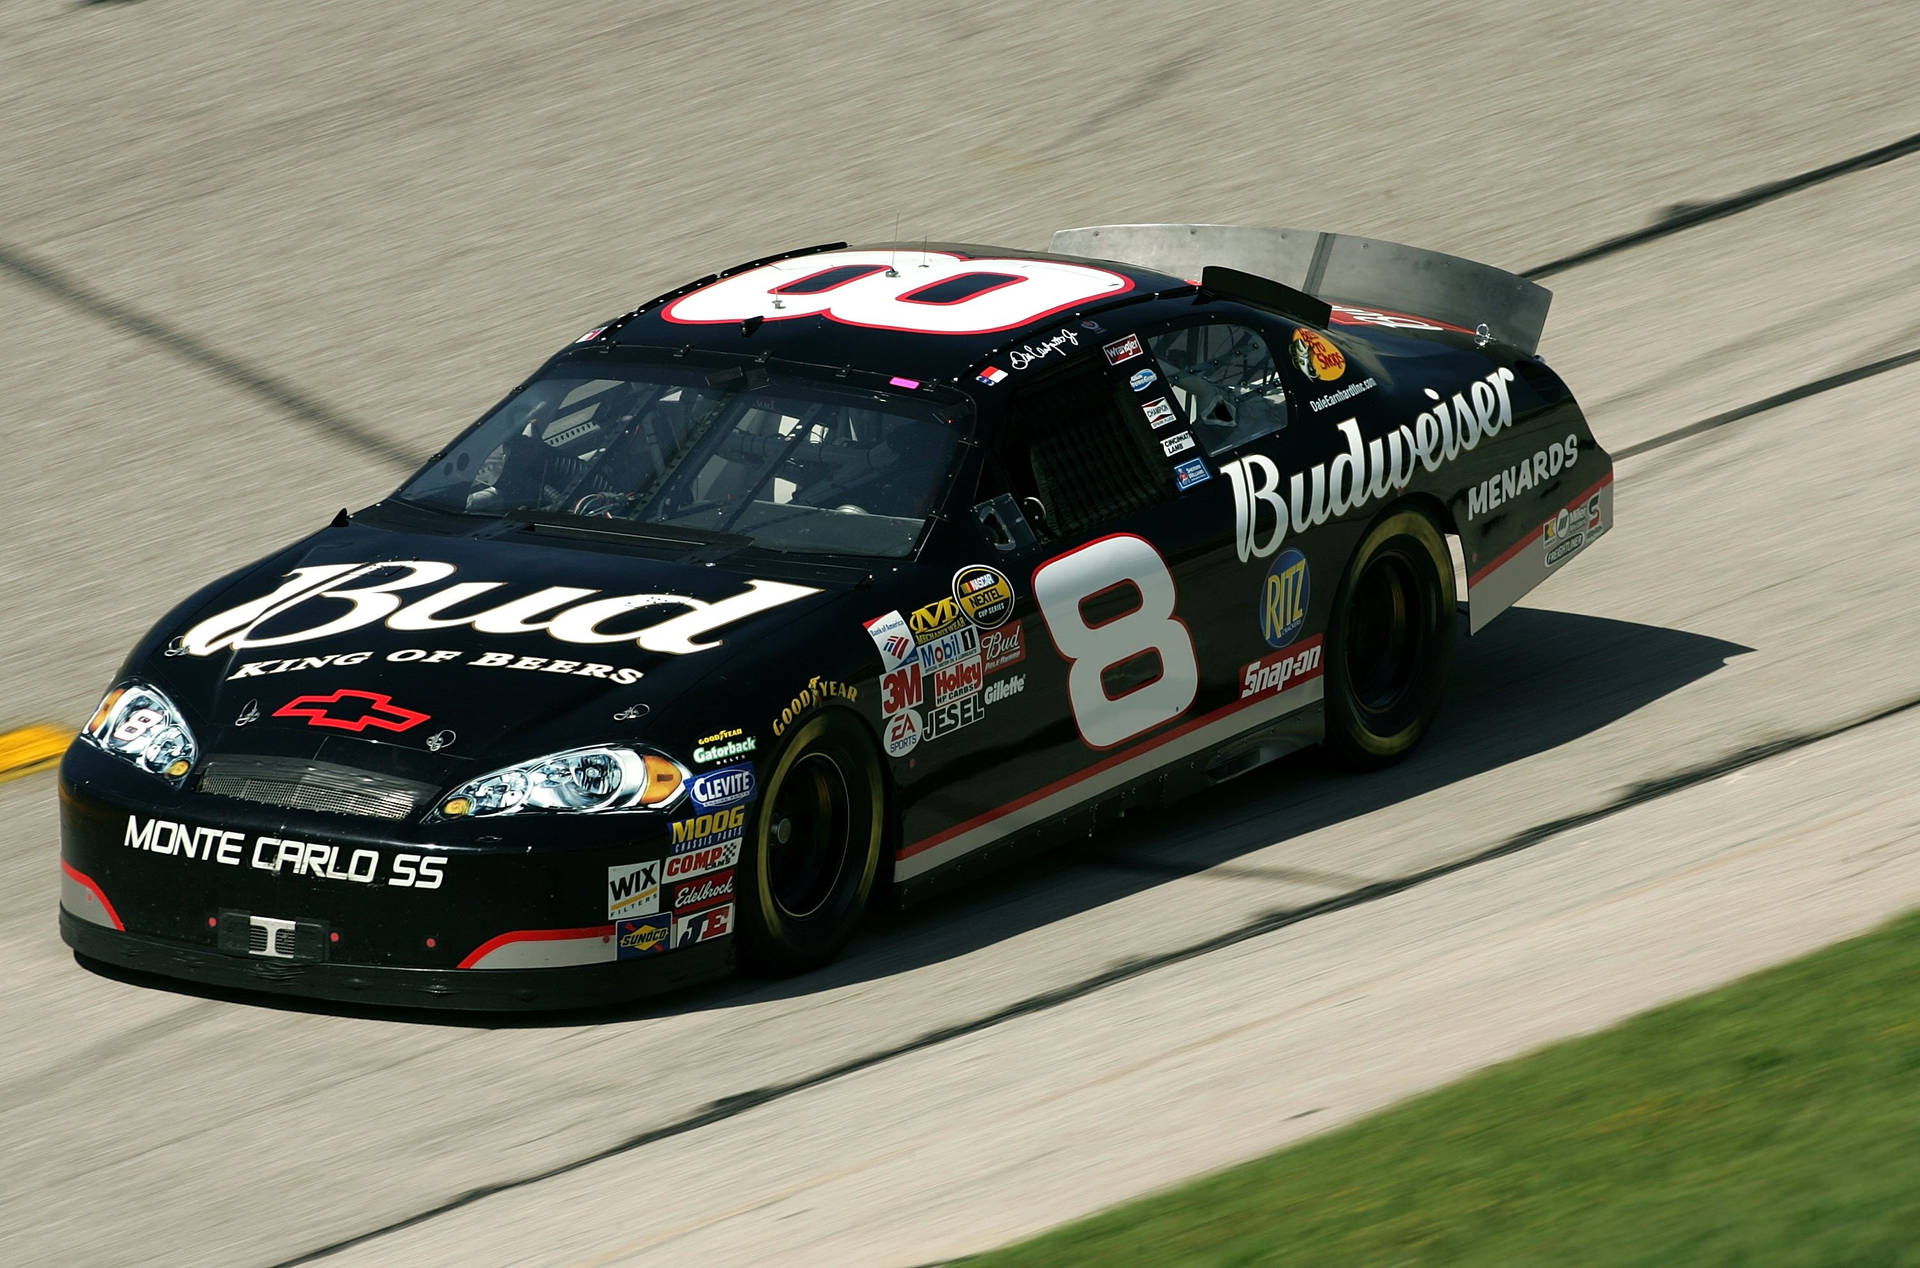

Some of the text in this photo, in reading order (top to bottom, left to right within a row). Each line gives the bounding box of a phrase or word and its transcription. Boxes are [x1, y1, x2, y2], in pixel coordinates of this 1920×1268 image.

[661, 250, 1135, 335] 8
[1107, 340, 1138, 358] Wrangler
[1317, 352, 1344, 370] Shops
[1147, 405, 1168, 418] CHAMPION
[1168, 443, 1184, 454] LAMB
[1219, 366, 1515, 563] Budweiser
[1468, 434, 1578, 521] MENARDS
[968, 588, 1003, 608] NEXTEL
[970, 573, 995, 591] NASCAR
[179, 560, 826, 657] Bud
[978, 602, 1005, 619] CUP SERIES
[1265, 559, 1306, 641] RITZ
[921, 633, 960, 669] Mobil
[981, 625, 1020, 661] Bud
[1032, 534, 1199, 748] 8
[225, 648, 645, 685] KING OF BEERS
[936, 661, 981, 696] Holley
[1241, 644, 1322, 699] Snap-on
[883, 663, 922, 714] 3M
[937, 684, 974, 704] HP CARBS
[984, 675, 1025, 706] Gillette
[772, 675, 858, 736] GOODYEAR
[923, 693, 984, 741] JESEL
[113, 708, 164, 742] 8
[698, 727, 743, 746] GOODYEAR
[891, 713, 916, 742] EA
[693, 736, 758, 765] Gatorback
[890, 735, 917, 753] SPORTS
[693, 772, 751, 803] CLEVITE
[671, 806, 745, 845] MOOG
[674, 826, 742, 853] CHASSIS PARTS
[124, 815, 448, 889] MONTE CARLO SS
[667, 847, 723, 877] COMP
[705, 857, 731, 871] CAMS
[609, 863, 657, 901] WIX
[675, 876, 735, 909] Edelbrock
[610, 893, 658, 918] FILTERS
[620, 927, 669, 948] SUNOCO
